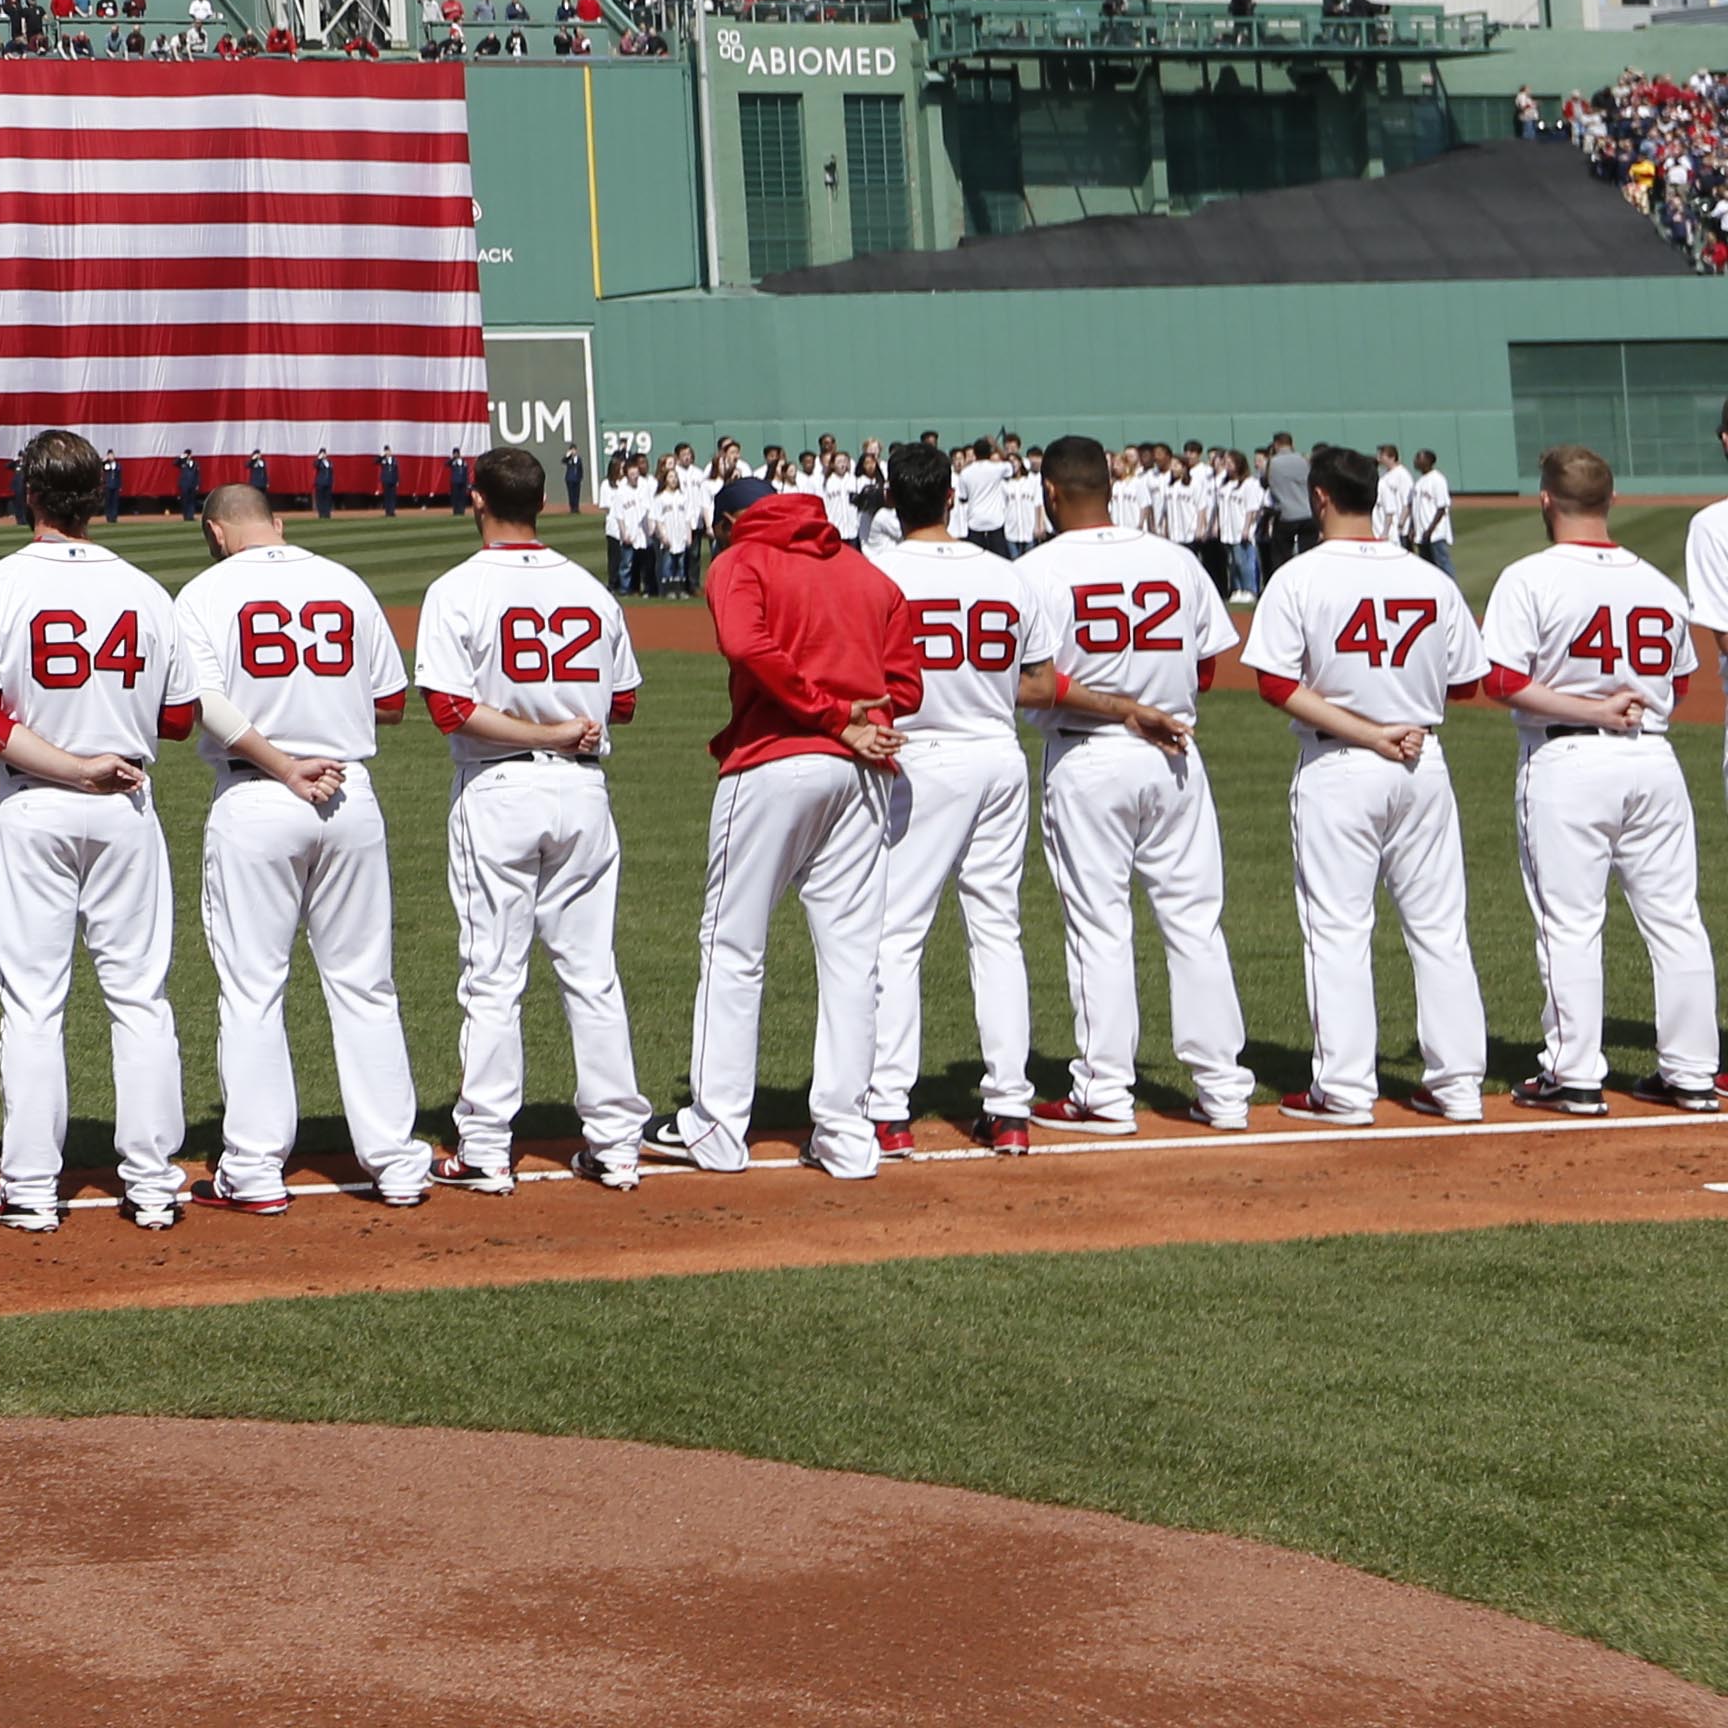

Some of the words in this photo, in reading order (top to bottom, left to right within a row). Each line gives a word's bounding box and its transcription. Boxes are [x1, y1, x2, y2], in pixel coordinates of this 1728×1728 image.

[747, 46, 896, 76] ABIOMED
[603, 430, 652, 459] 379
[29, 609, 146, 690] 64
[237, 600, 354, 679] 63
[499, 606, 602, 684] 62
[907, 597, 1020, 672] 56
[1071, 580, 1184, 654] 52
[1335, 597, 1438, 668] 47
[1568, 605, 1675, 677] 46
